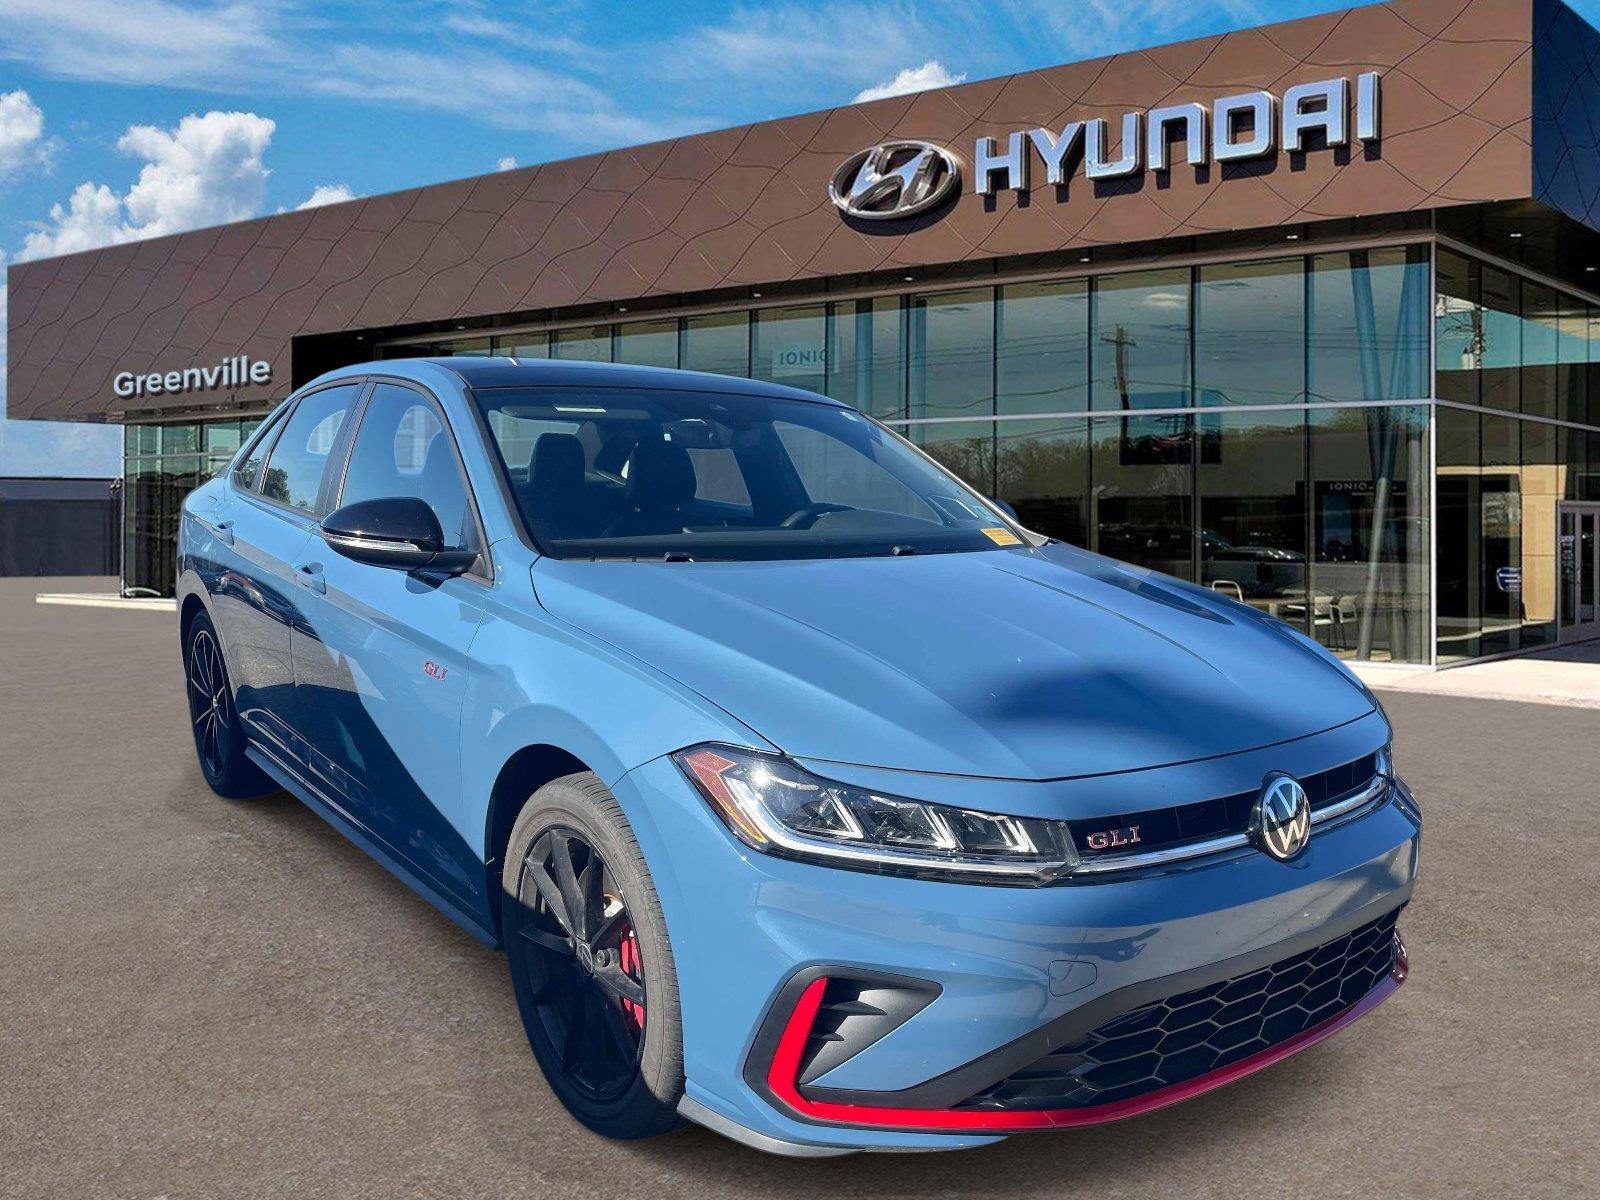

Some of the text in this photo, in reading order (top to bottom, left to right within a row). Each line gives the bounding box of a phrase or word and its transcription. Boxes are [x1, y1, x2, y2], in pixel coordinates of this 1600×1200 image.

[975, 71, 1382, 195] HYUNDAI
[113, 355, 272, 397] Greenville
[423, 660, 449, 682] GLI
[1086, 825, 1141, 850] GLI
